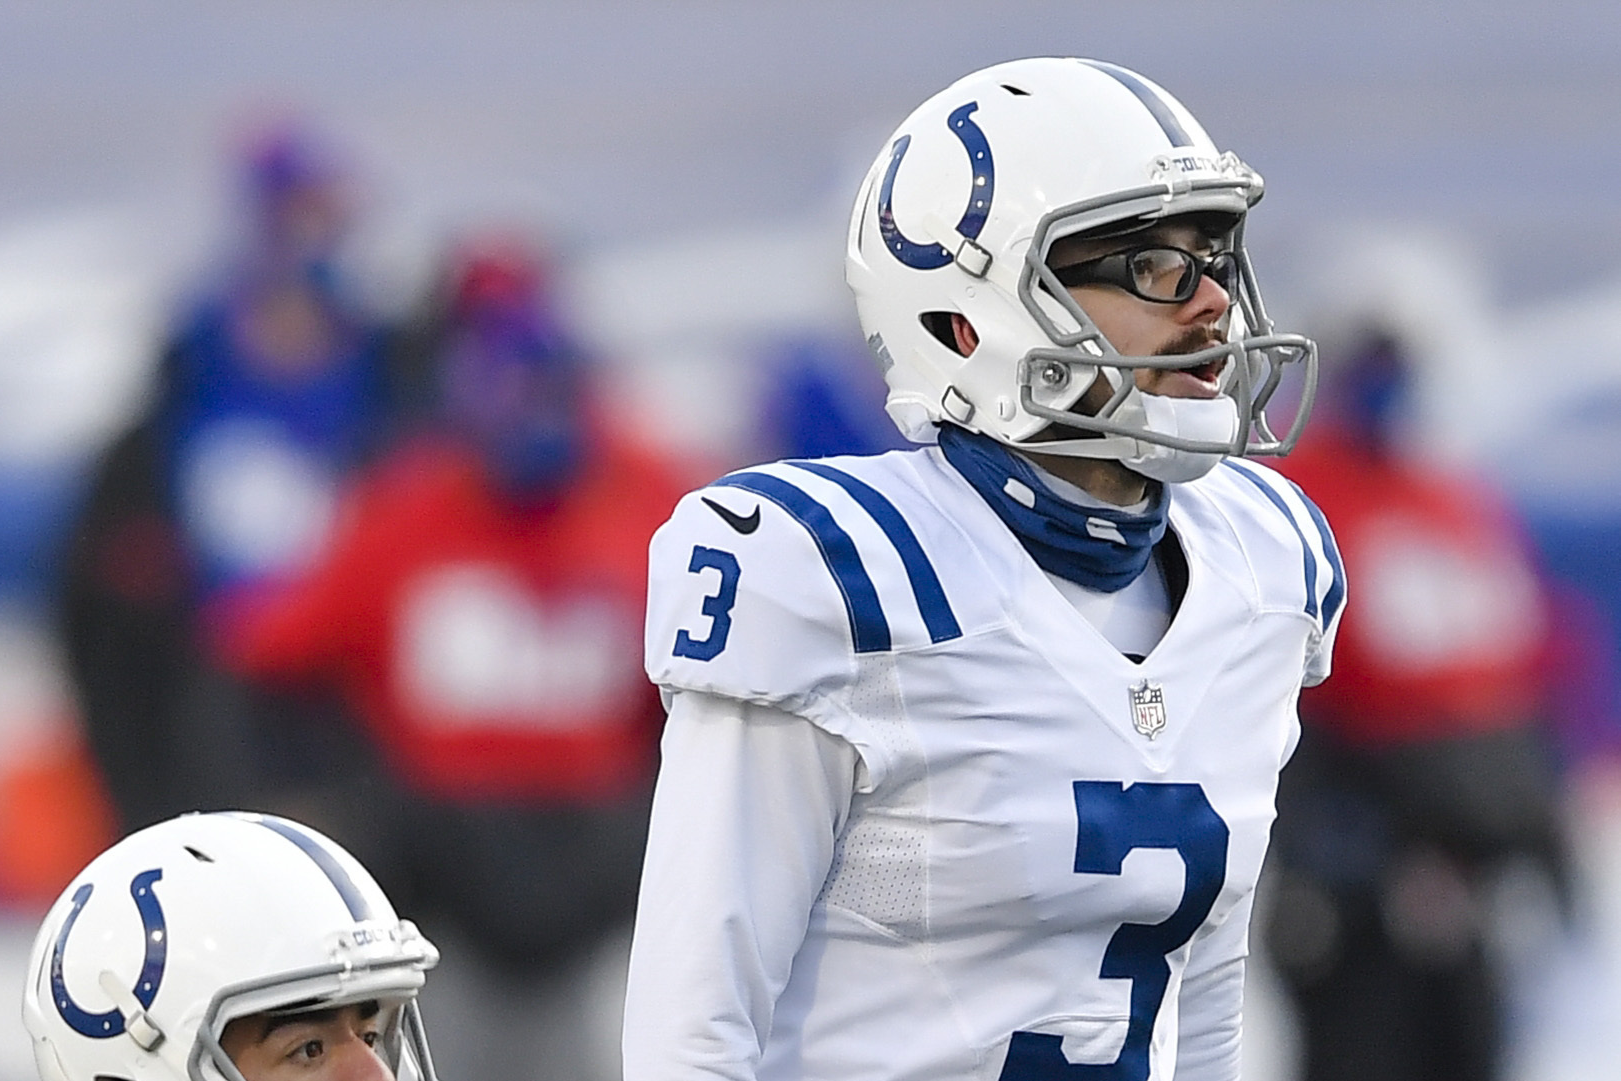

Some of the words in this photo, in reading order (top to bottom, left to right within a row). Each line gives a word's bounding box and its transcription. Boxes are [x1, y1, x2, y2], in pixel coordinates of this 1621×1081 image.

[671, 545, 741, 662] 3
[1139, 705, 1162, 727] NFL
[352, 929, 397, 946] COL
